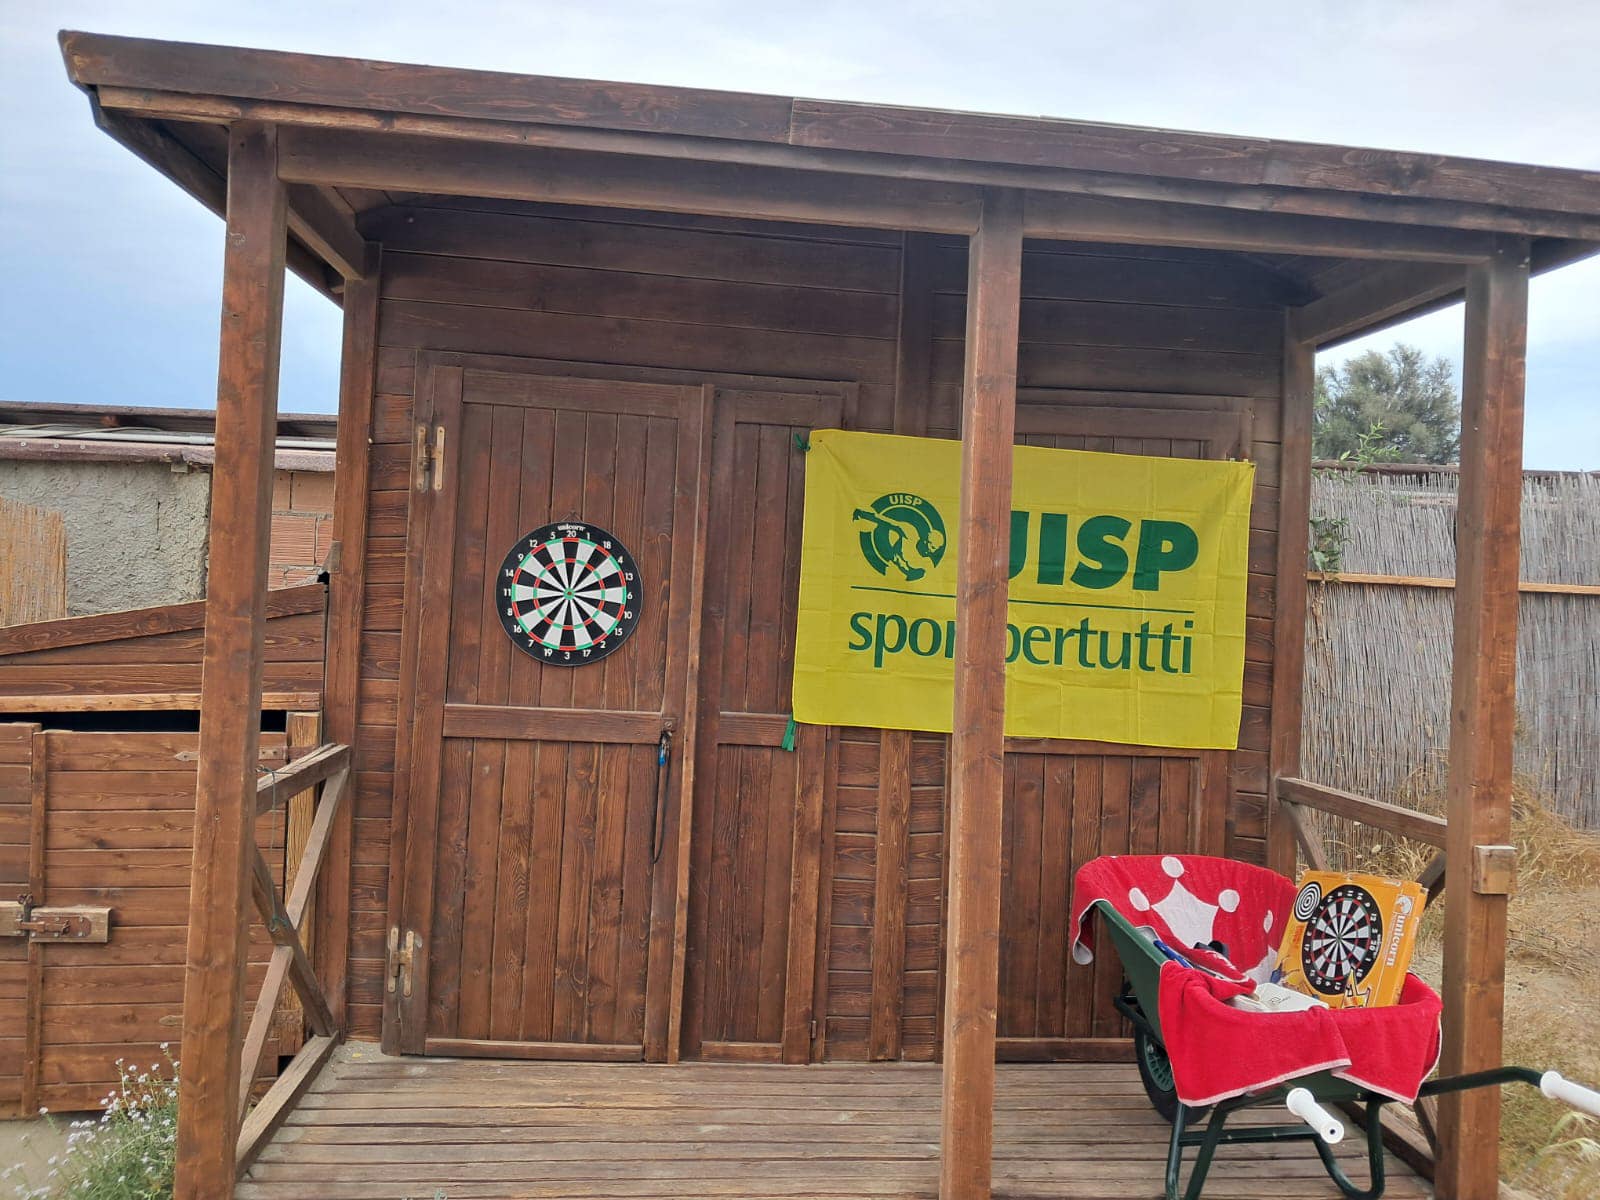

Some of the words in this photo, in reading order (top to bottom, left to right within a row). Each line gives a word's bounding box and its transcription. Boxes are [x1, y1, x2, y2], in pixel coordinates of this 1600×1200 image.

[889, 494, 922, 506] UISP
[603, 541, 611, 549] 18
[505, 569, 514, 577] 14
[615, 628, 622, 636] 15
[1386, 915, 1406, 966] unicorn
